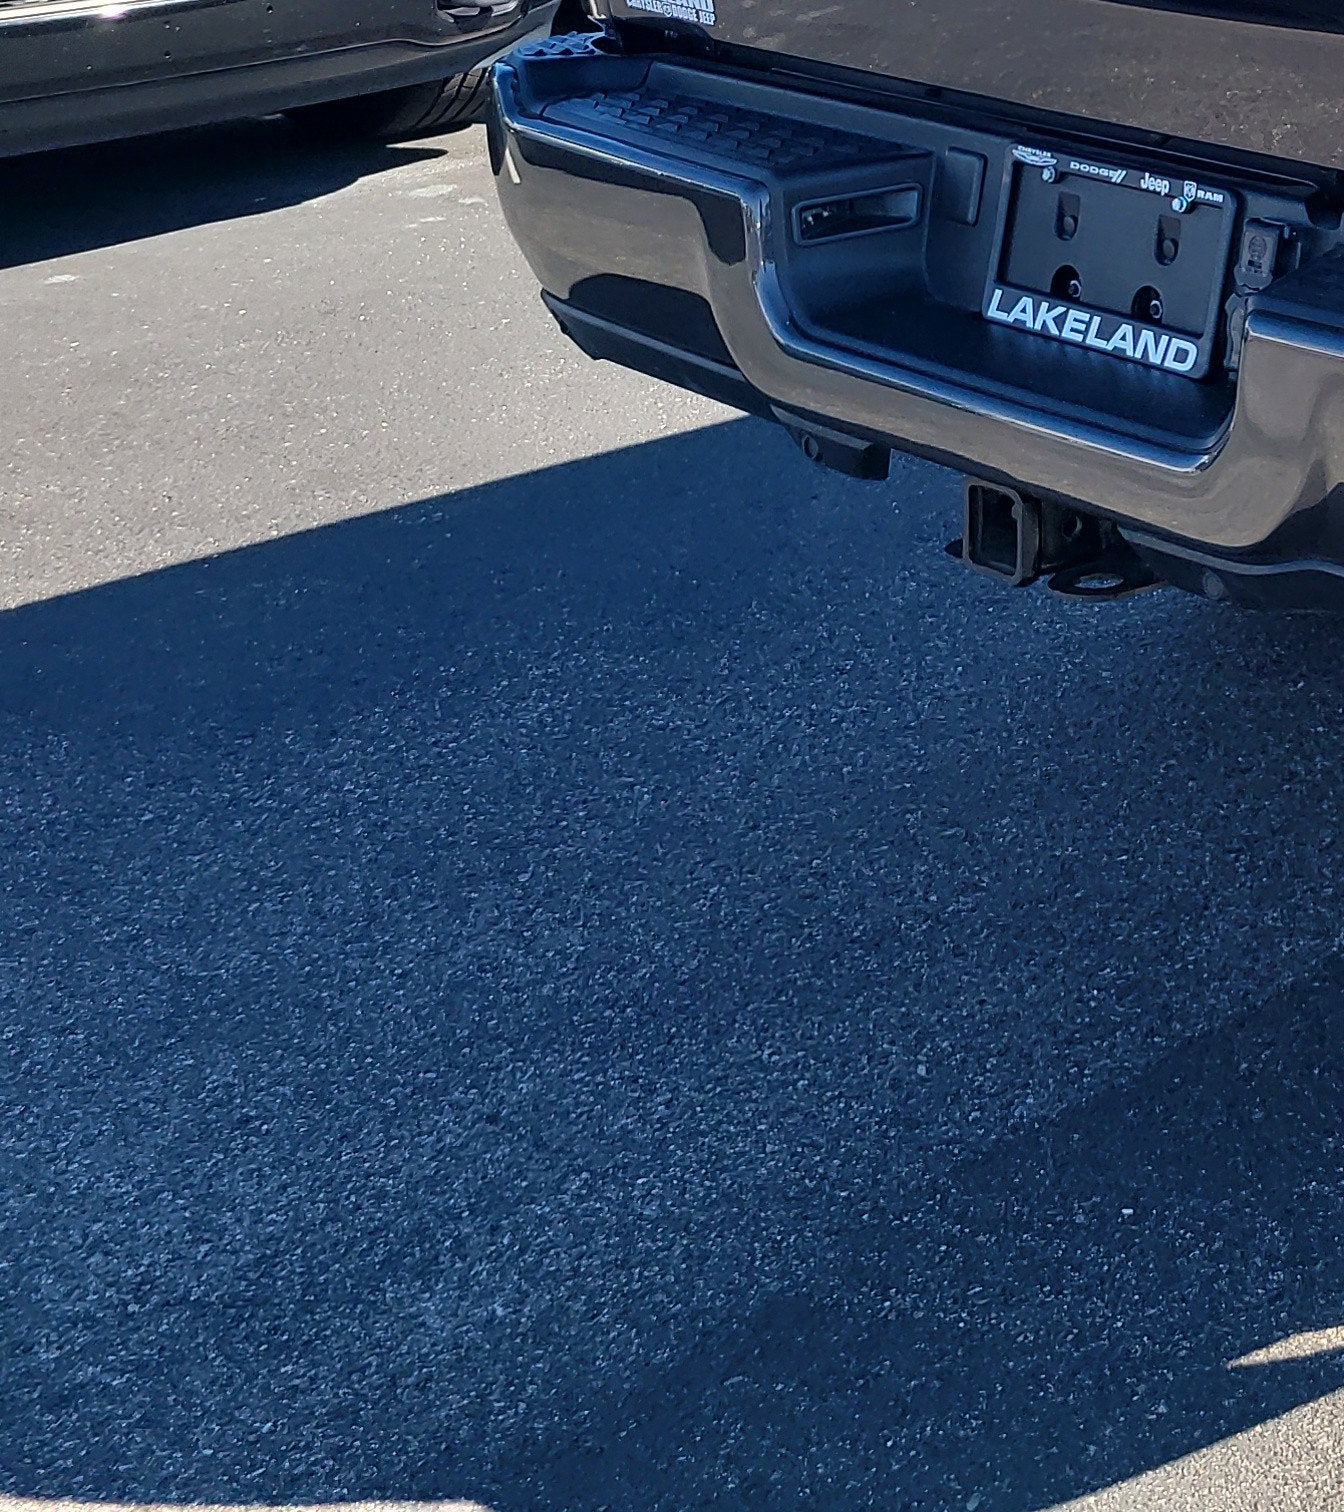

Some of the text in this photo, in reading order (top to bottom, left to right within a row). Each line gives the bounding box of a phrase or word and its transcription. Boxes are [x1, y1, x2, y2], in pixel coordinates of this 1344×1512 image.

[1069, 161, 1117, 180] DODGE
[1140, 172, 1170, 196] Jeep
[1196, 189, 1224, 203] RAM
[986, 288, 1198, 372] LAKELAND
